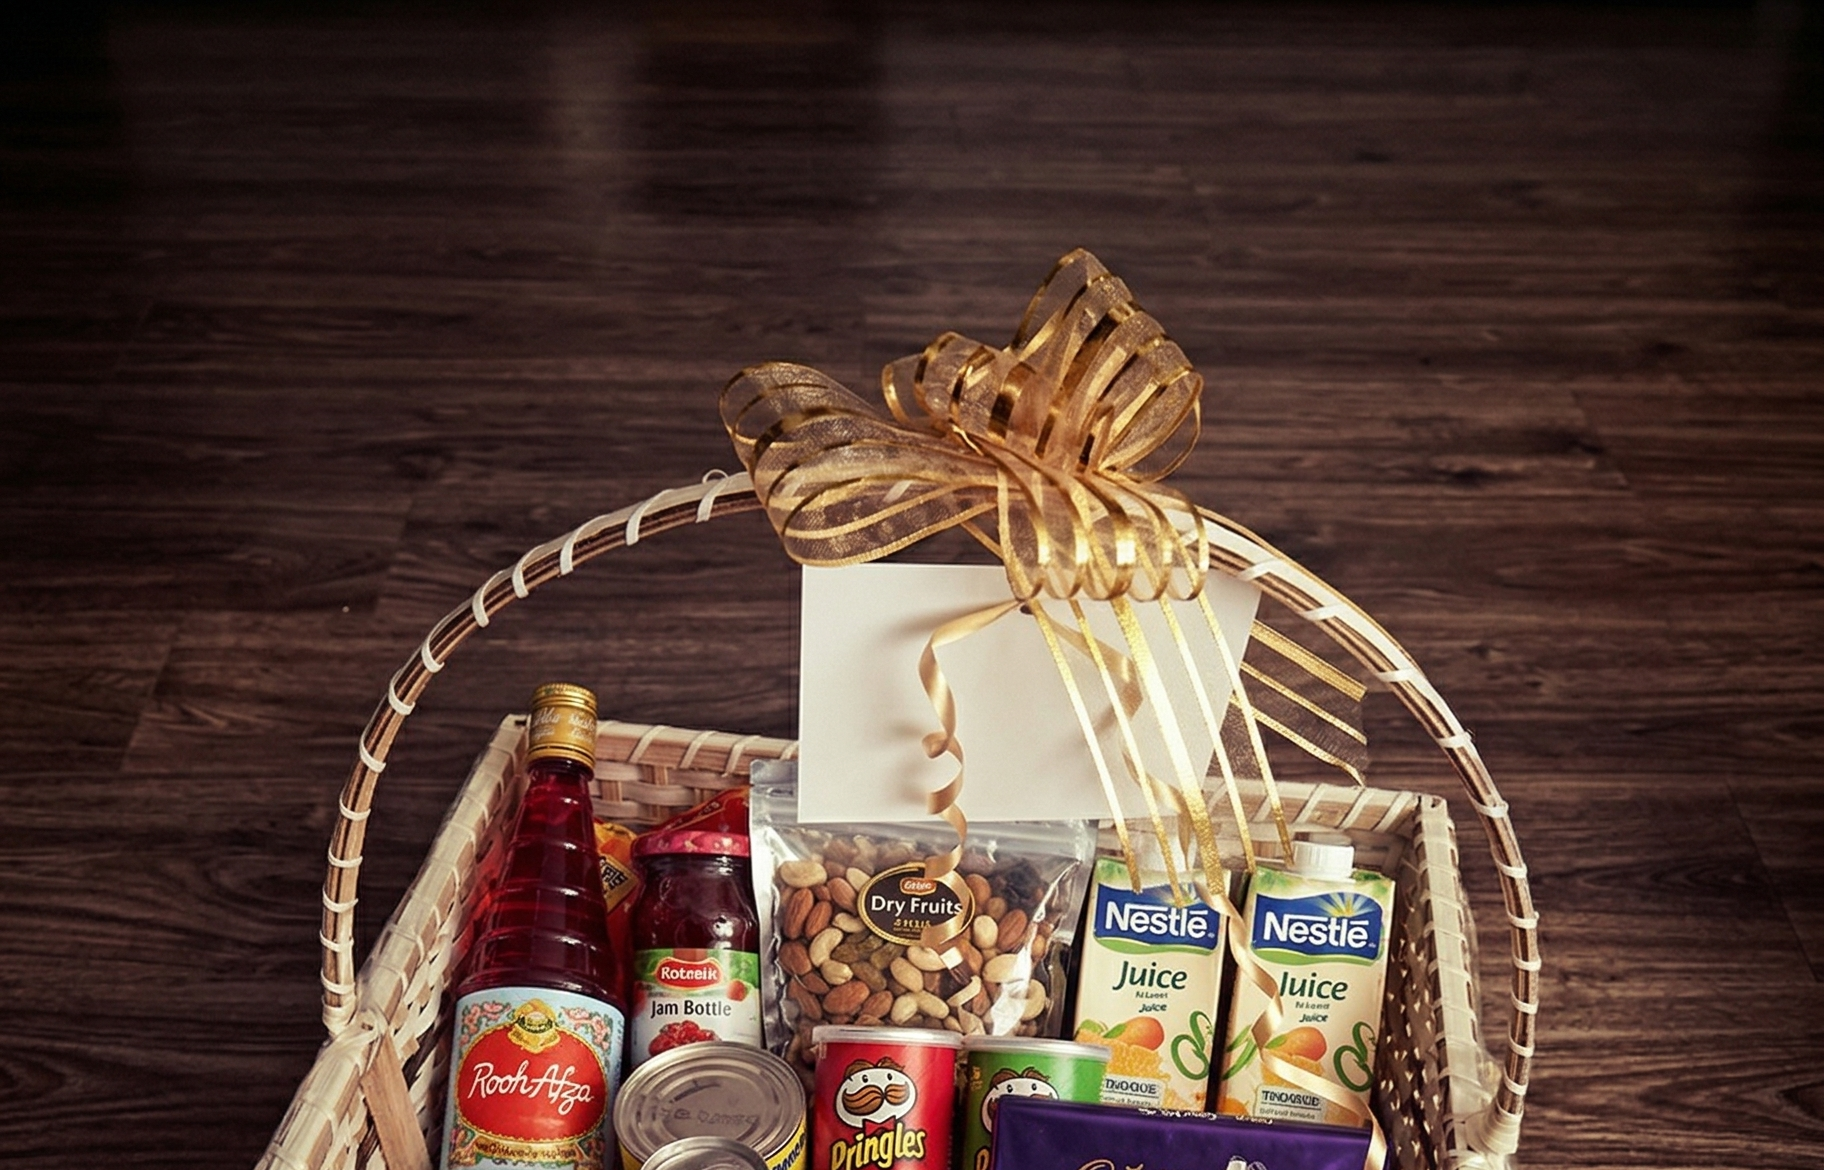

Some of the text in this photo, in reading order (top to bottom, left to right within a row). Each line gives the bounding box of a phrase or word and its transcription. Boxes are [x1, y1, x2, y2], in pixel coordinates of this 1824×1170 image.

[871, 895, 963, 917] Dry Fruits
[1112, 960, 1188, 991] Juice
[650, 999, 732, 1019] Jam Bottle
[467, 1060, 595, 1115] Rooh Afza
